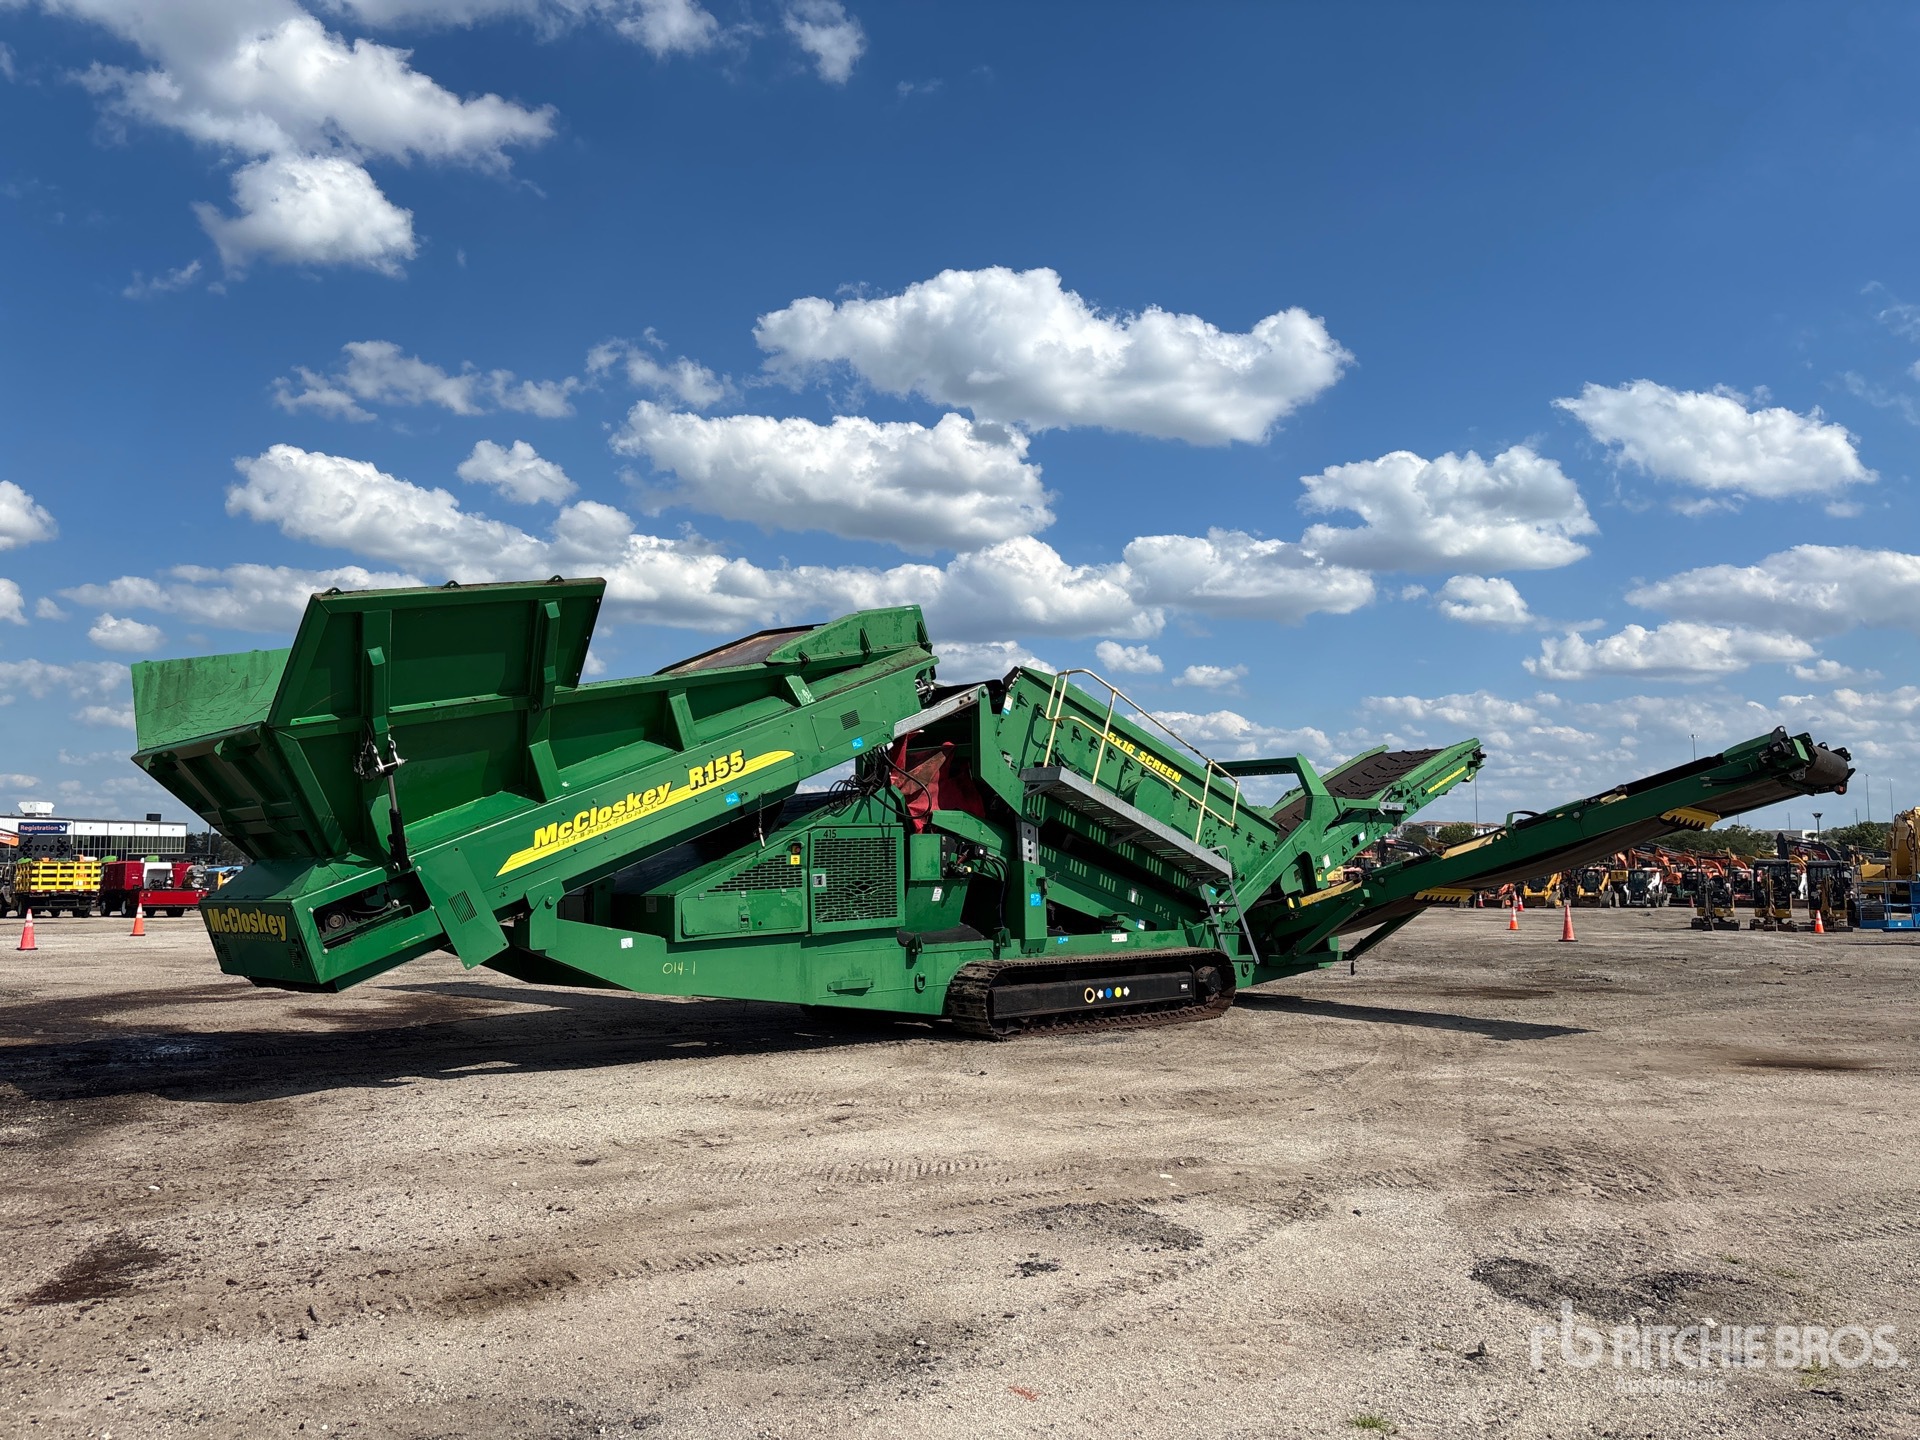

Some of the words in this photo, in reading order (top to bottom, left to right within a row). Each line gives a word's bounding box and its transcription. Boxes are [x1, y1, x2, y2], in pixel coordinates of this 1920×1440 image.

[1107, 731, 1136, 755] 5x16
[1138, 751, 1182, 783] SCREEN
[533, 781, 673, 850] McCloskey
[688, 749, 746, 790] R155
[20, 824, 59, 832] Registration
[557, 803, 660, 848] INTERNATIONAL
[823, 829, 837, 839] 415
[207, 907, 287, 942] McCloskey
